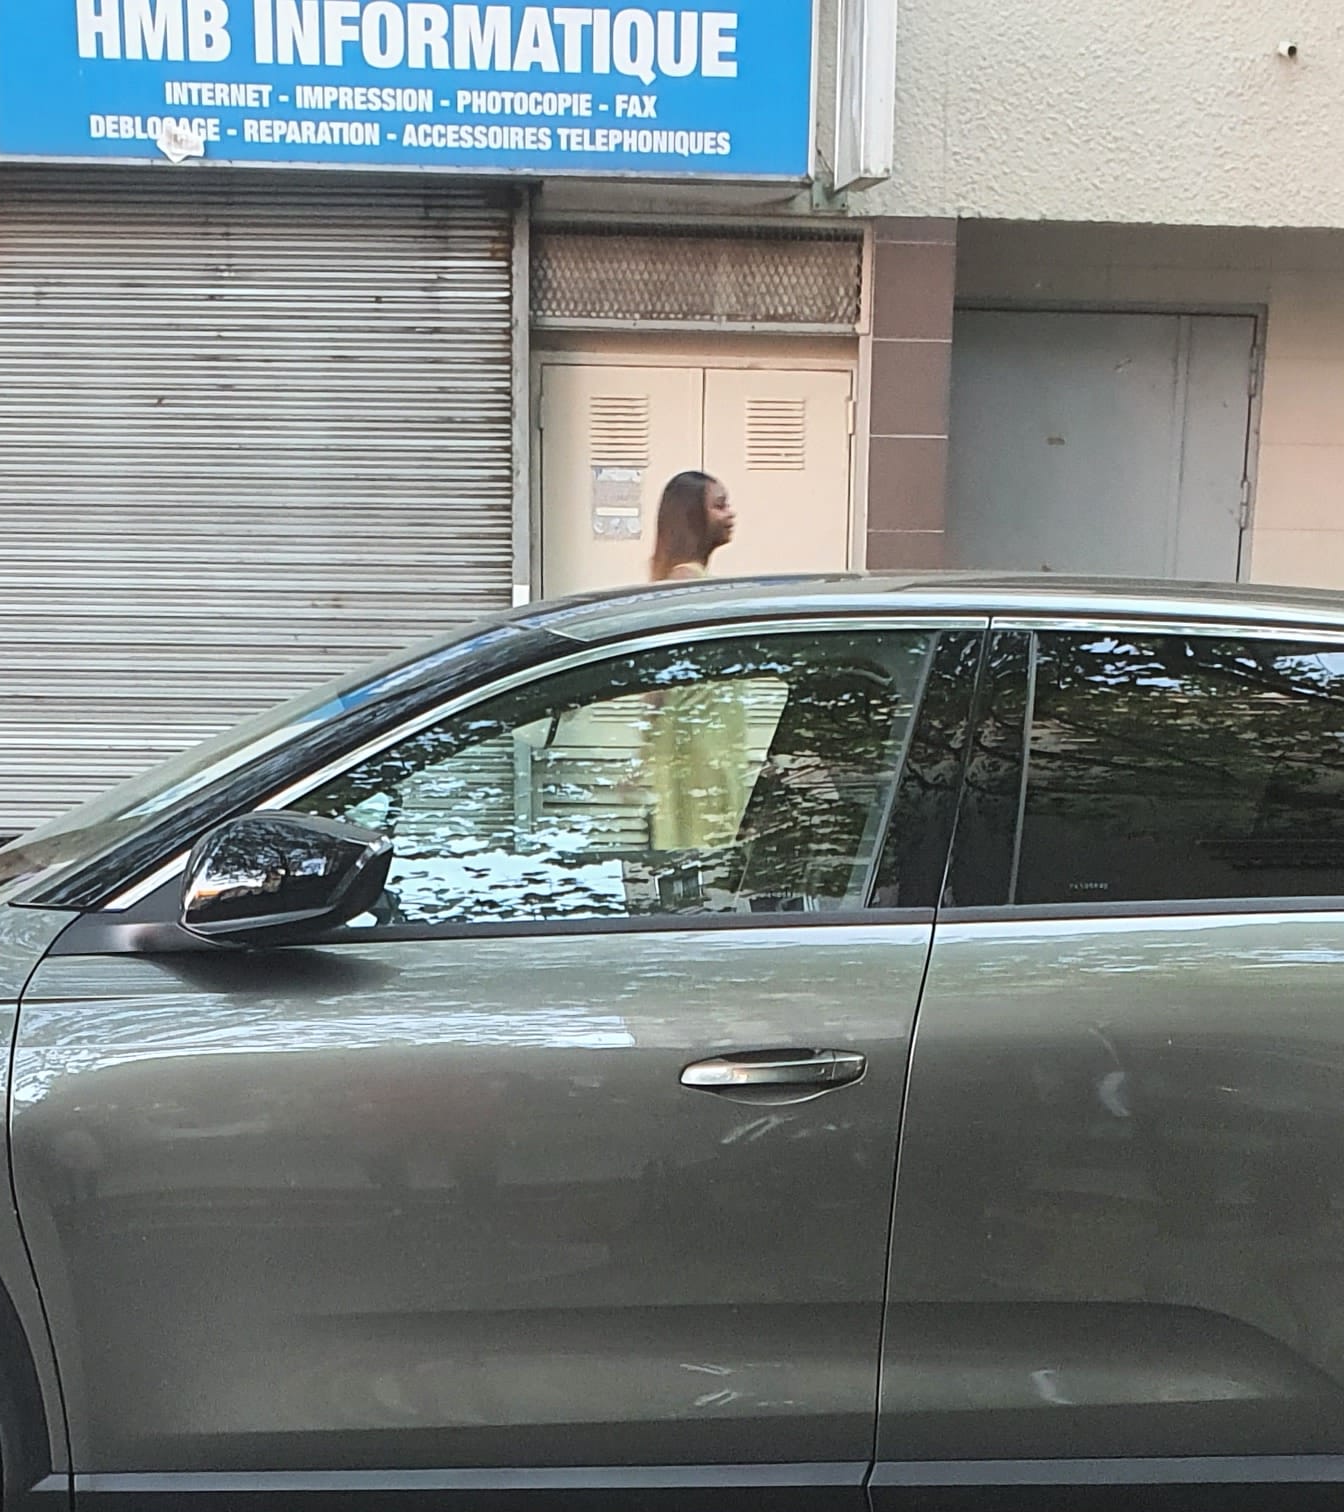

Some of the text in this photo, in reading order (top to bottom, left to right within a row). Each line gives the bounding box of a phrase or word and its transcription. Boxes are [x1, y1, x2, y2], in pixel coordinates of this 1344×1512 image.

[77, 0, 738, 86] HMB INFORMATIQUE
[165, 81, 273, 108] INTERNET
[295, 85, 433, 112] IMPRESSION
[457, 89, 592, 117] PHOTOCOPIE
[615, 94, 657, 118] FAX
[243, 119, 380, 146] REPARATION
[402, 124, 552, 151] ACCESSOIRES
[557, 128, 731, 157] TELEPHONIQUES
